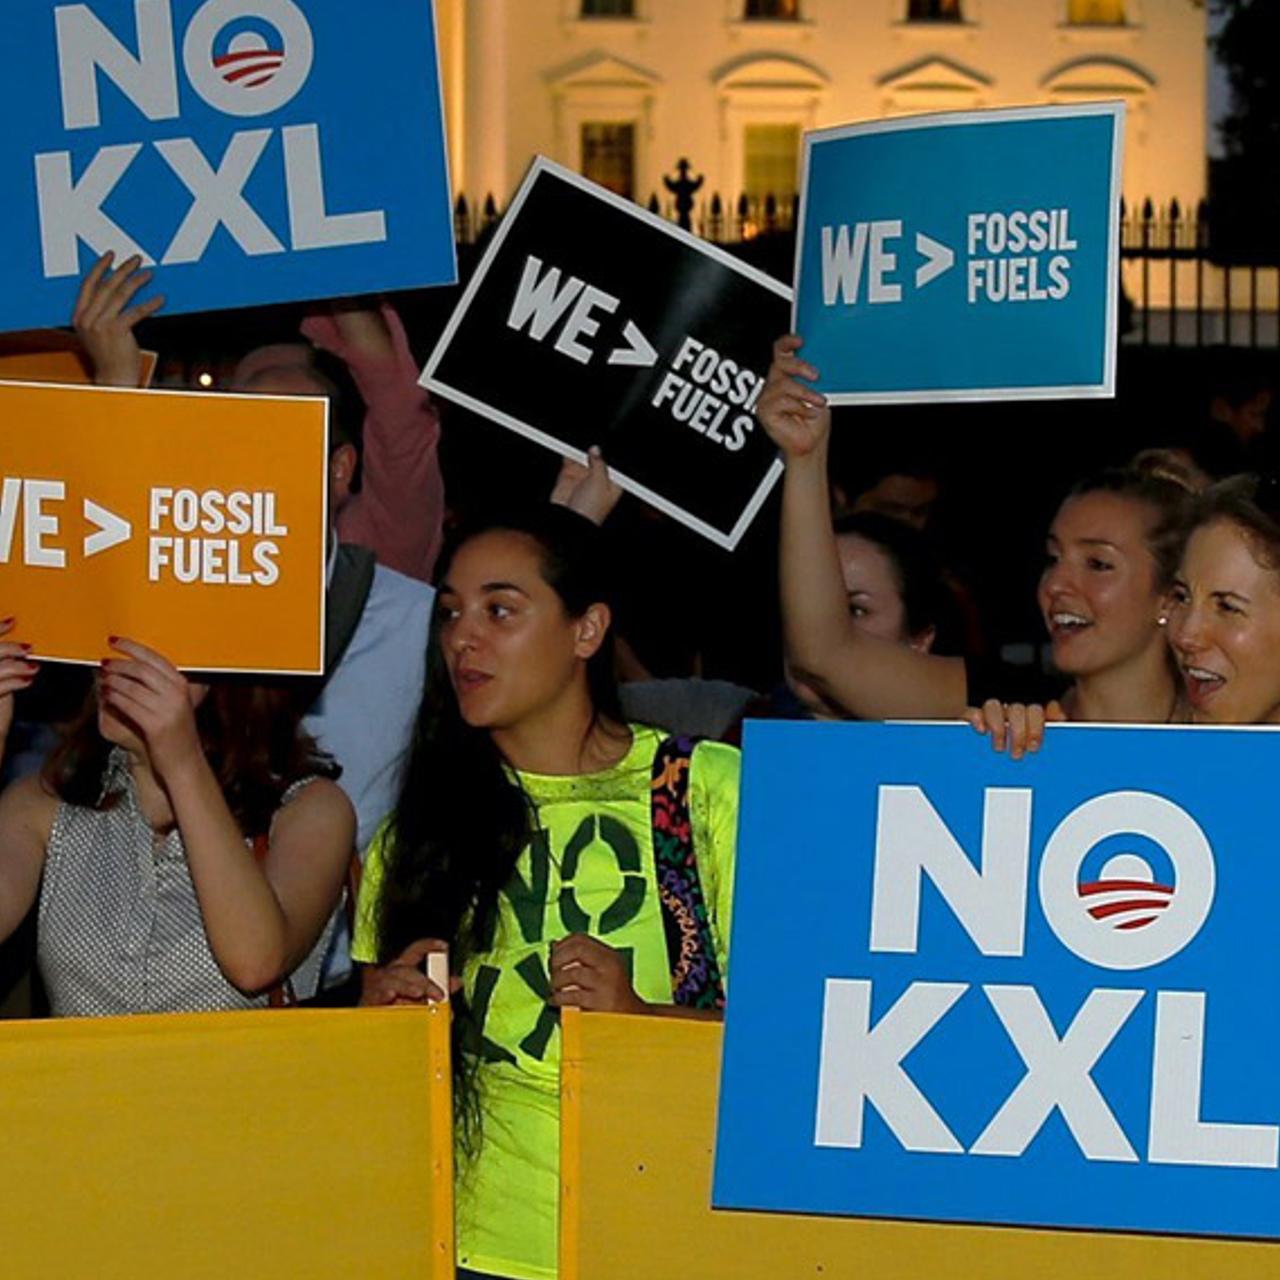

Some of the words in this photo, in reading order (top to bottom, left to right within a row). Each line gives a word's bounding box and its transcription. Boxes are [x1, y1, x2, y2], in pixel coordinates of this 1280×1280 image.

[34, 122, 387, 279] KXL
[967, 208, 1078, 255] FOSSIL
[821, 220, 903, 306] WE
[967, 255, 1071, 304] FUELS
[506, 253, 621, 365] WE
[651, 370, 755, 452] FUELS
[671, 335, 766, 414] FOSSI
[149, 487, 288, 537] FOSSIL
[148, 537, 281, 587] FUELS
[868, 783, 1217, 972] NO
[815, 977, 1280, 1171] KXL
